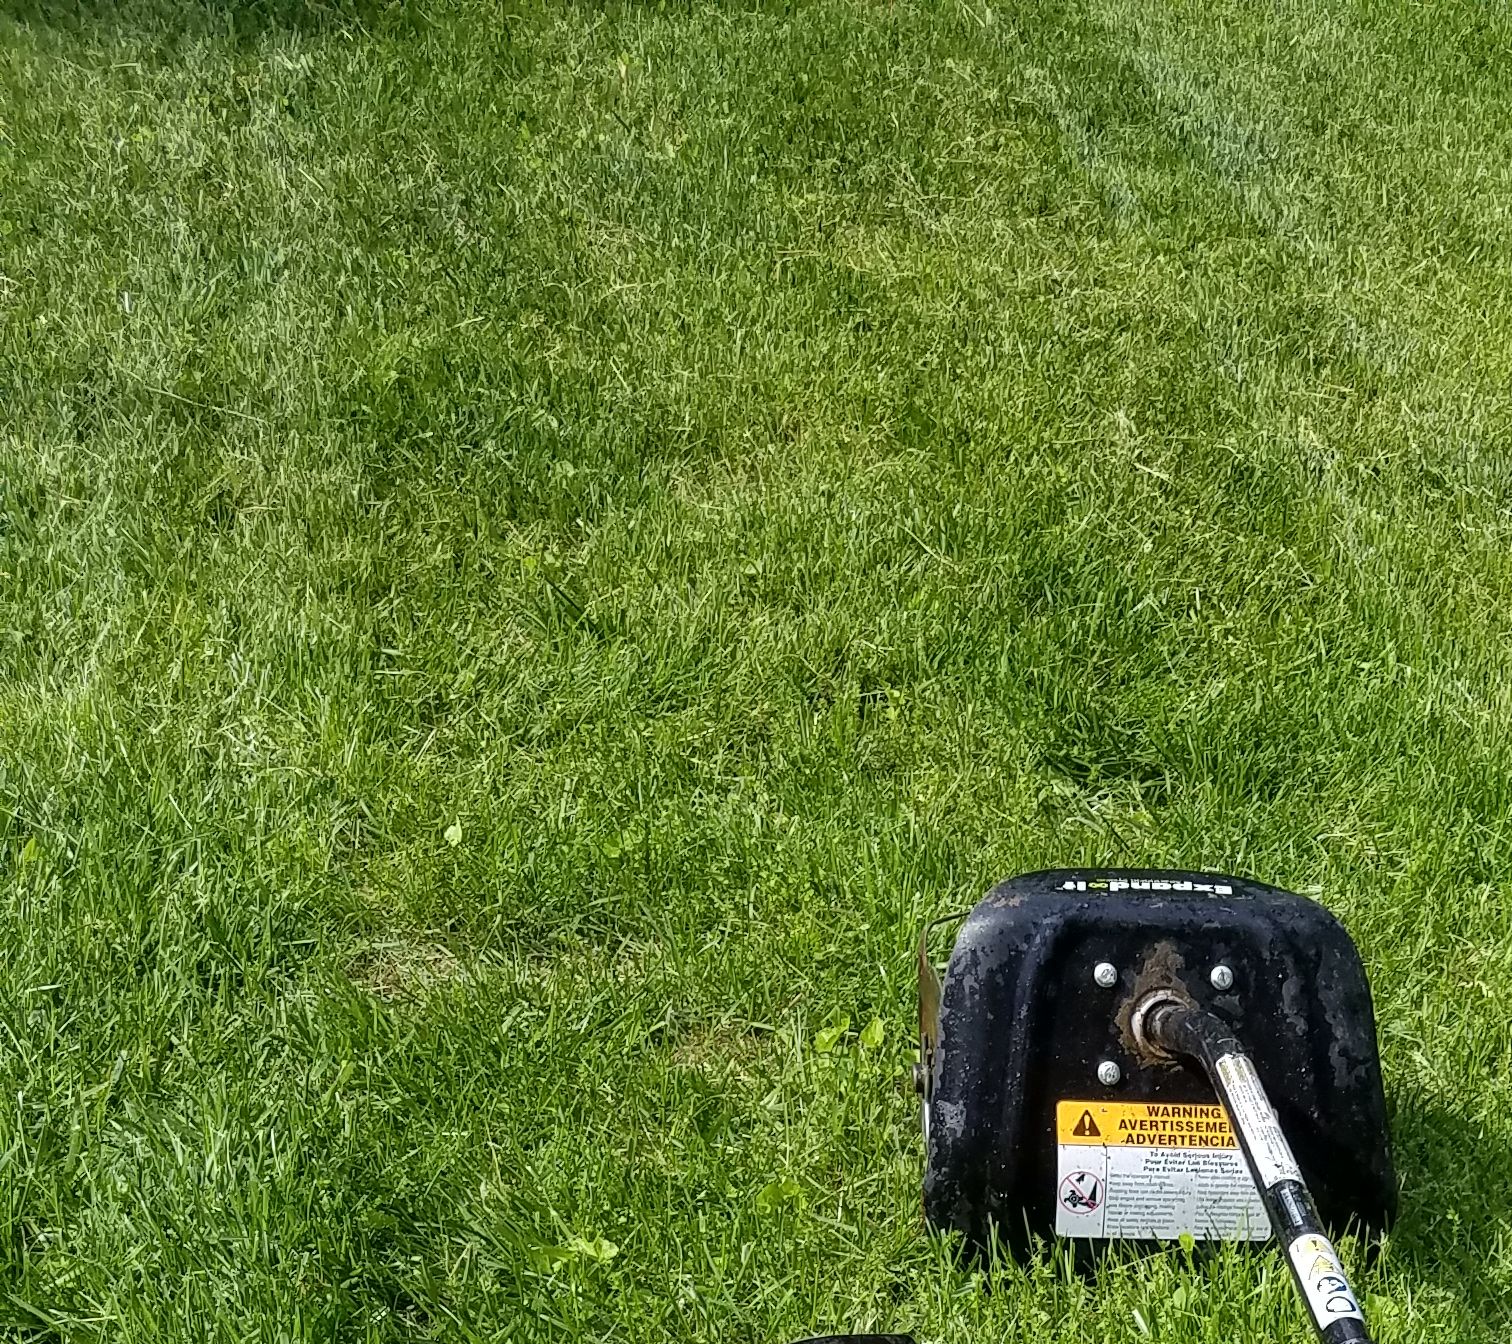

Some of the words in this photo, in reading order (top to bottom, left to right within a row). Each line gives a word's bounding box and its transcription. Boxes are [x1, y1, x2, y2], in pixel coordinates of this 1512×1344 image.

[1146, 1105, 1221, 1119] WARNING
[1125, 1133, 1236, 1147] ADVERTENCIA
[1182, 1152, 1210, 1160] Serious
[1212, 1153, 1234, 1161] Injury
